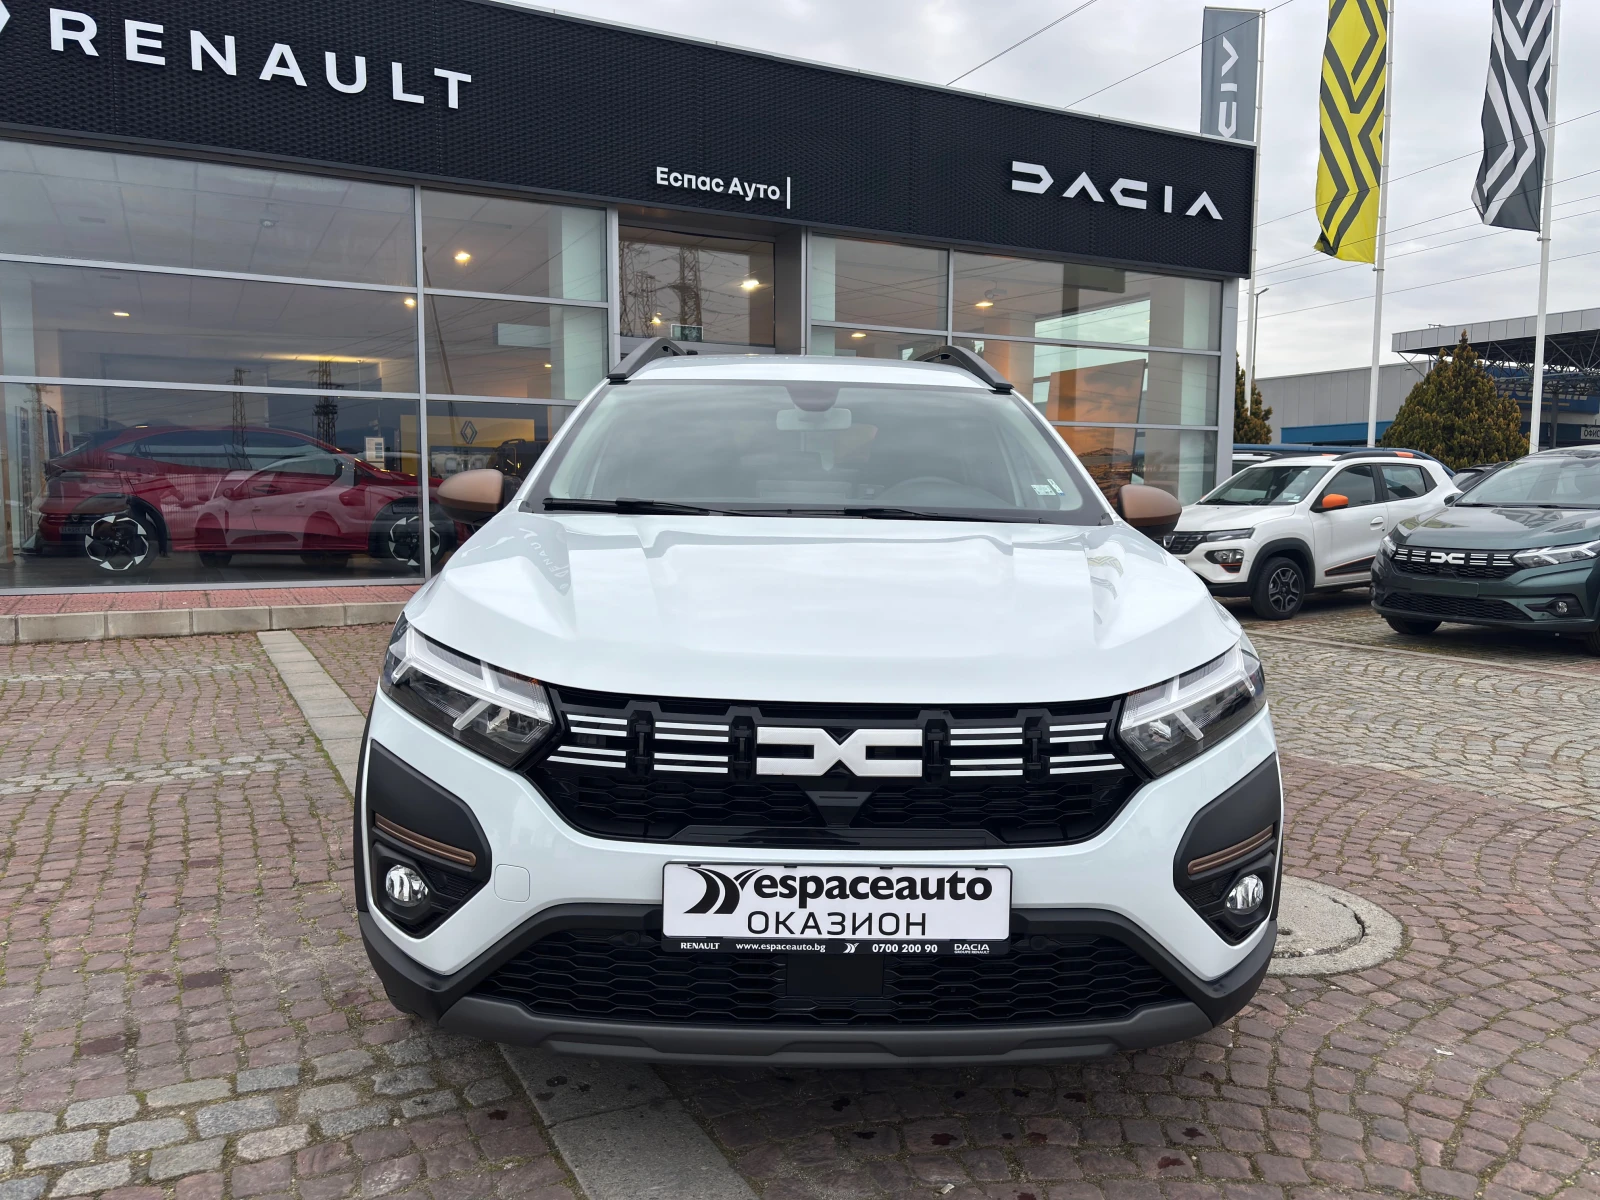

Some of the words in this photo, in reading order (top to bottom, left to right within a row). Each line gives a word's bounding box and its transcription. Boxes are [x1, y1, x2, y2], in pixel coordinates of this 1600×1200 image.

[49, 7, 472, 109] RENAULT
[656, 166, 725, 193] Еспас
[728, 177, 780, 201] Ауто
[1011, 160, 1224, 221] DACIA
[753, 870, 993, 909] espaceauto
[747, 910, 927, 936] ОКАЗИОН
[680, 942, 720, 950] RENAULT
[736, 943, 826, 952] www.espaceauto.bg
[872, 943, 899, 953] 0700
[901, 943, 921, 953] 200
[924, 944, 938, 953] 90
